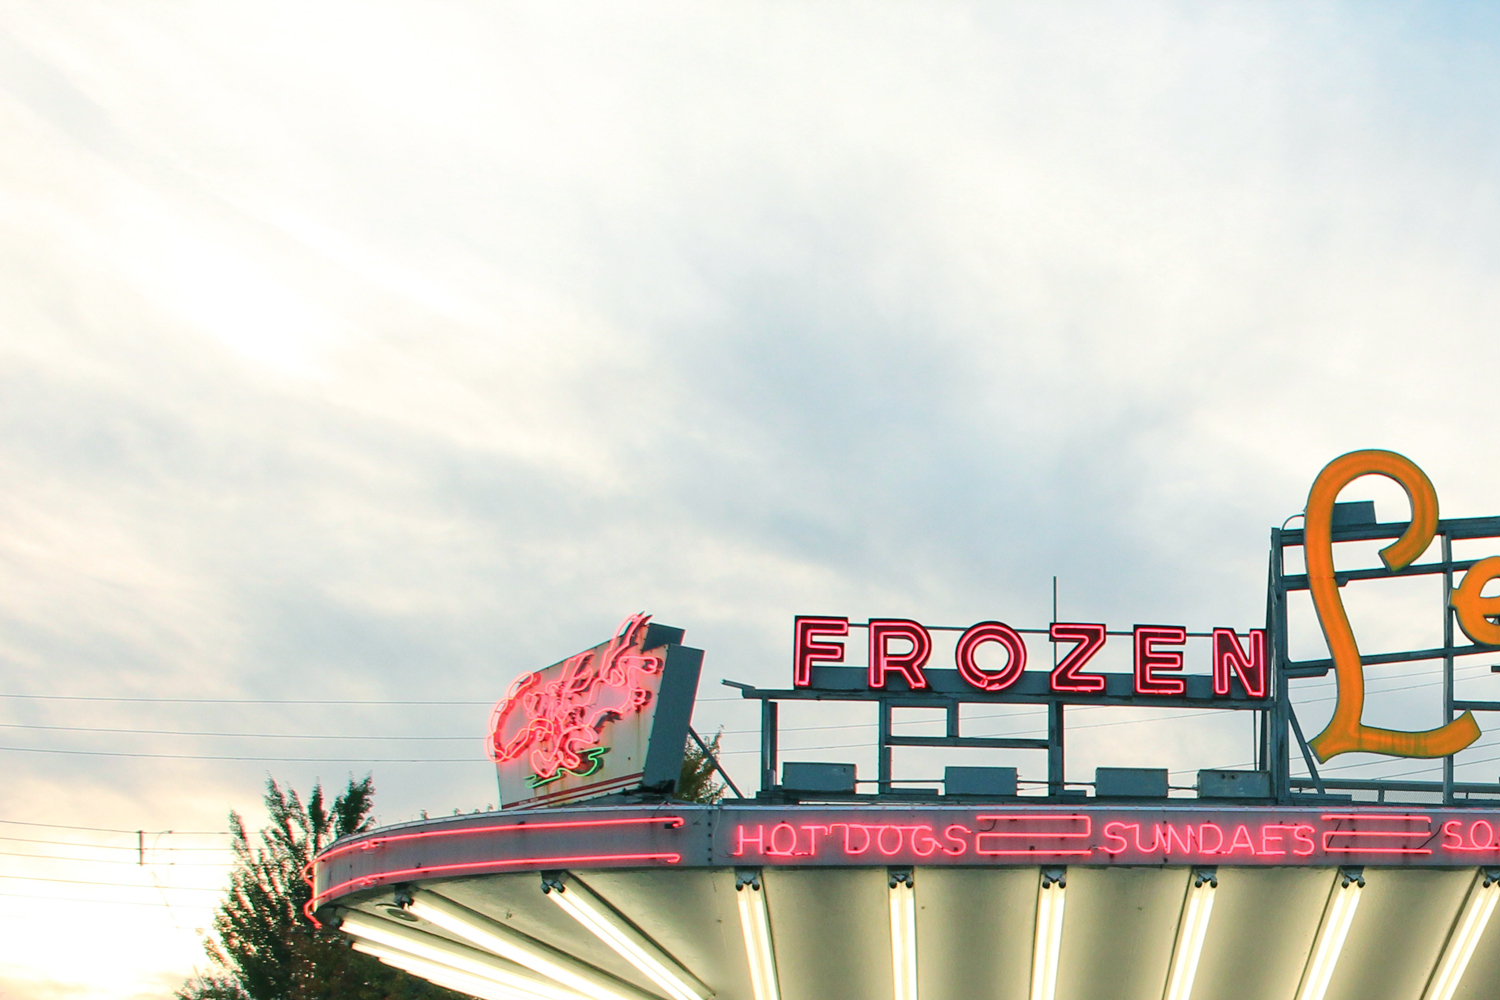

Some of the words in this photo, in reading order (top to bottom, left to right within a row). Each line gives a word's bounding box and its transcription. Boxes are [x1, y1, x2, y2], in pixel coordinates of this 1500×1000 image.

[794, 615, 1267, 698] FROZEN
[732, 820, 829, 859] HOT
[838, 820, 973, 858] DOGS
[1100, 820, 1317, 858] SUNDAES
